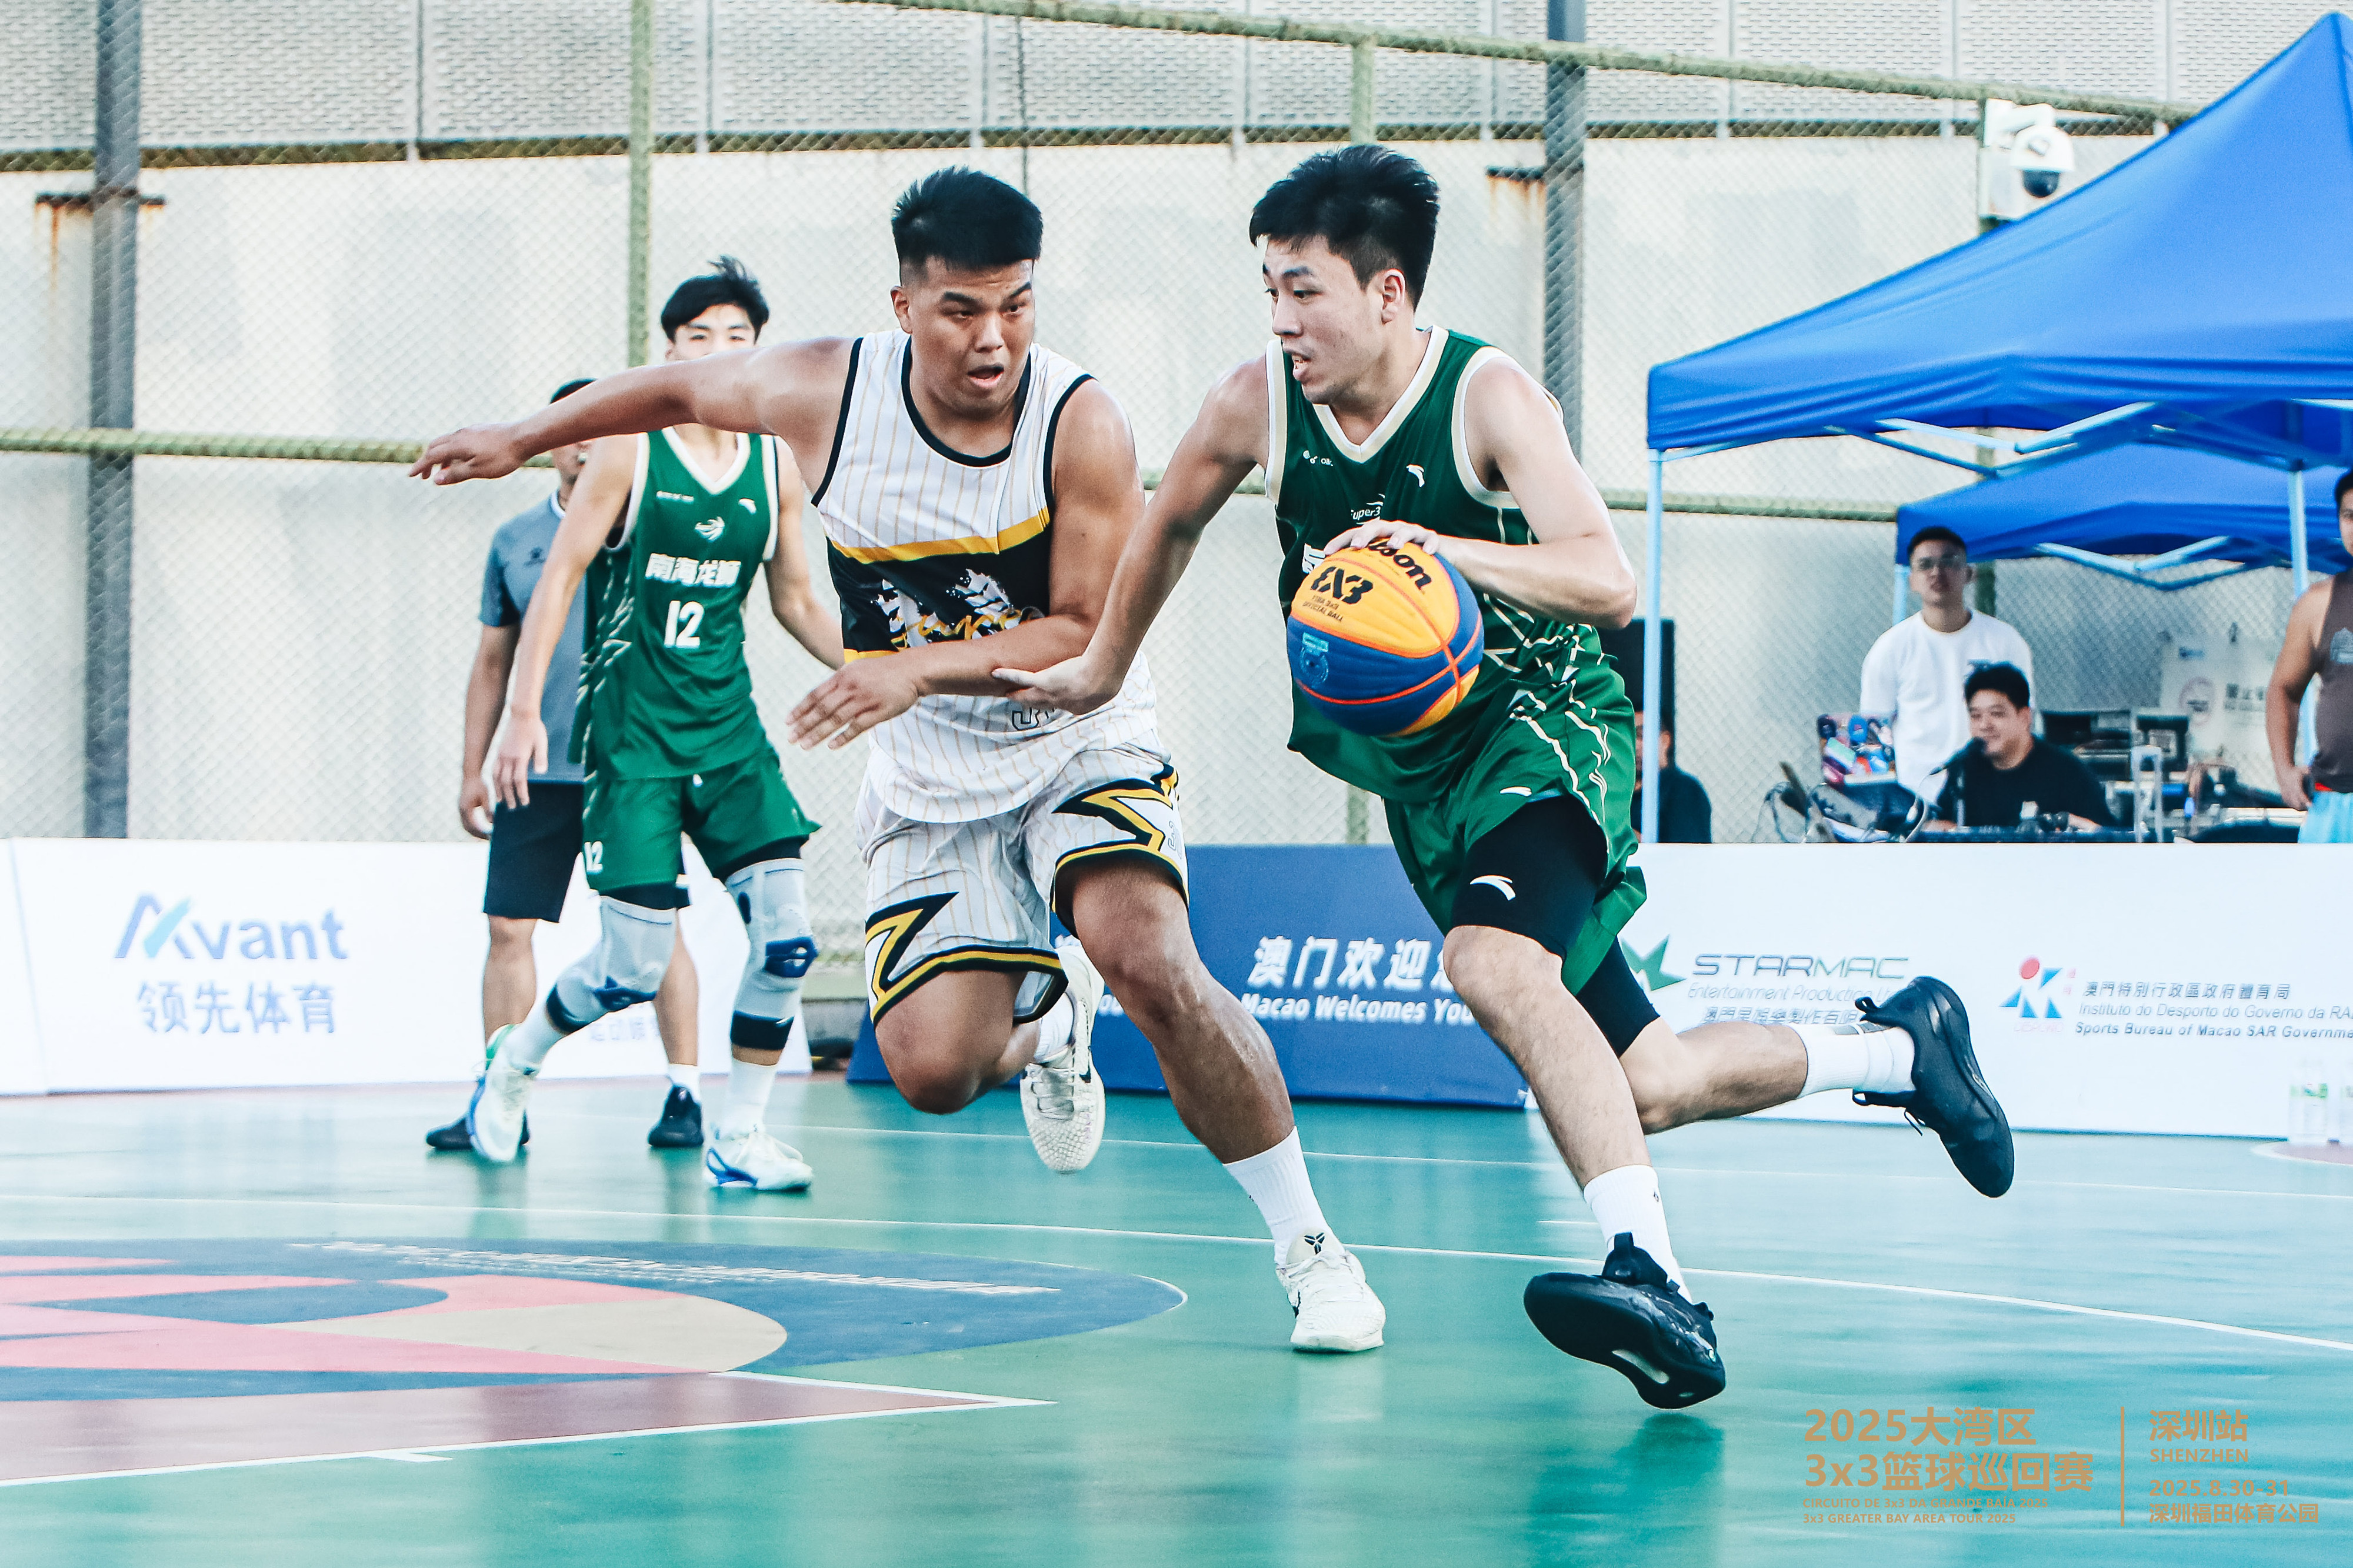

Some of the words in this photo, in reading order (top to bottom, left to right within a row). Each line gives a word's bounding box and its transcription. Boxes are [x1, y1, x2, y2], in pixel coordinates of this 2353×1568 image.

[1351, 506, 1381, 521] uper3
[664, 600, 701, 648] 12
[584, 840, 604, 873] 12
[1692, 953, 1909, 979] STARMAC
[1687, 982, 1791, 1000] Entertainment
[137, 980, 336, 1034] 领先体育
[1241, 993, 1310, 1021] Macao
[1315, 994, 1428, 1025] Welcomes
[2079, 1003, 2131, 1016] Instituto
[2135, 1004, 2152, 1016] do
[2156, 1003, 2218, 1019] Desporto
[2222, 1005, 2239, 1018] do
[2244, 1005, 2304, 1019] Governo
[2308, 1006, 2325, 1019] da
[2329, 1006, 2353, 1019] RA
[2076, 1022, 2119, 1036] Sports
[2124, 1022, 2173, 1036] Bureau
[2178, 1023, 2194, 1036] of
[2197, 1024, 2242, 1037] Macao
[2246, 1025, 2278, 1037] SAR
